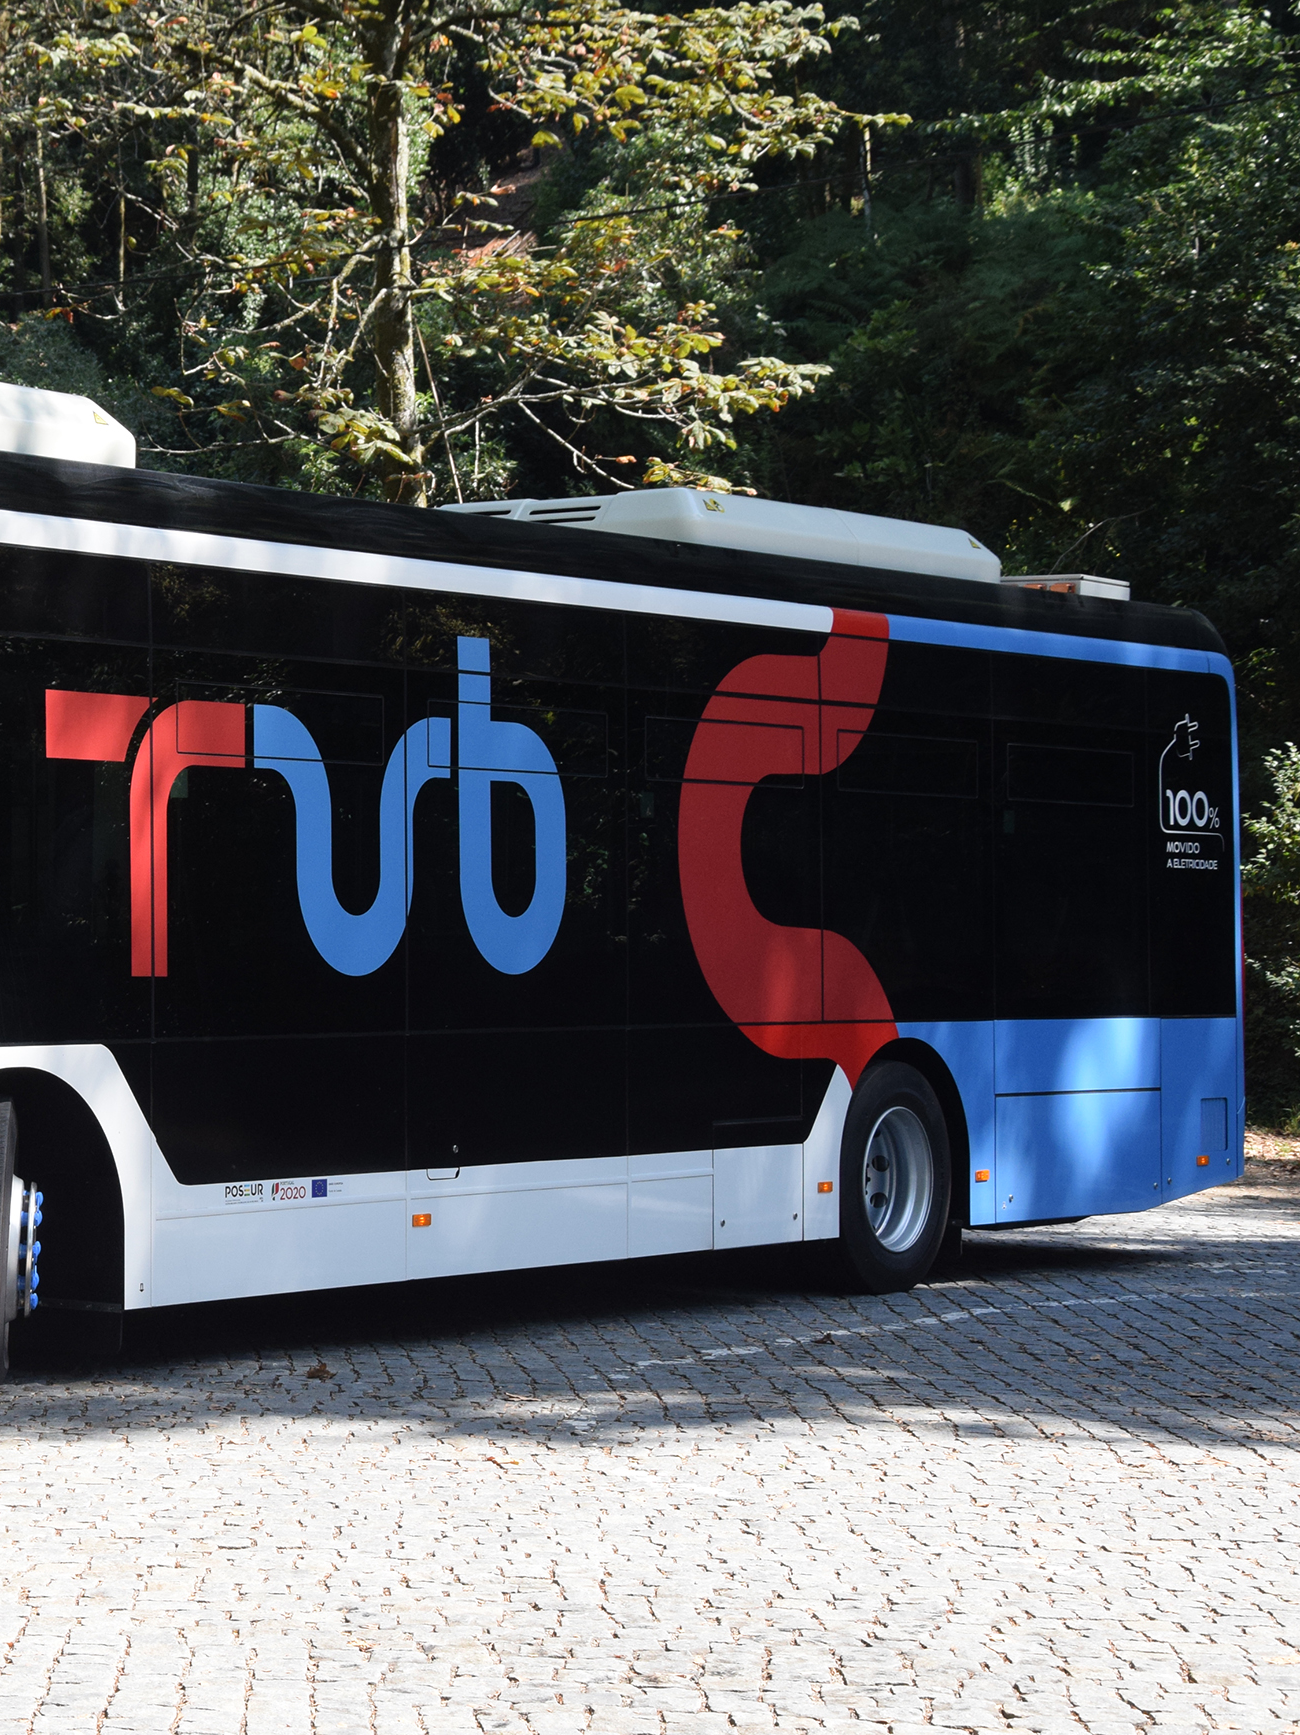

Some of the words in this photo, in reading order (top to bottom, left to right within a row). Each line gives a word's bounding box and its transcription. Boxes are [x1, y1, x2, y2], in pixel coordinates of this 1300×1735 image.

[1165, 789, 1220, 829] 100%
[1166, 841, 1201, 854] MOVIDO
[280, 1186, 307, 1201] 2020
